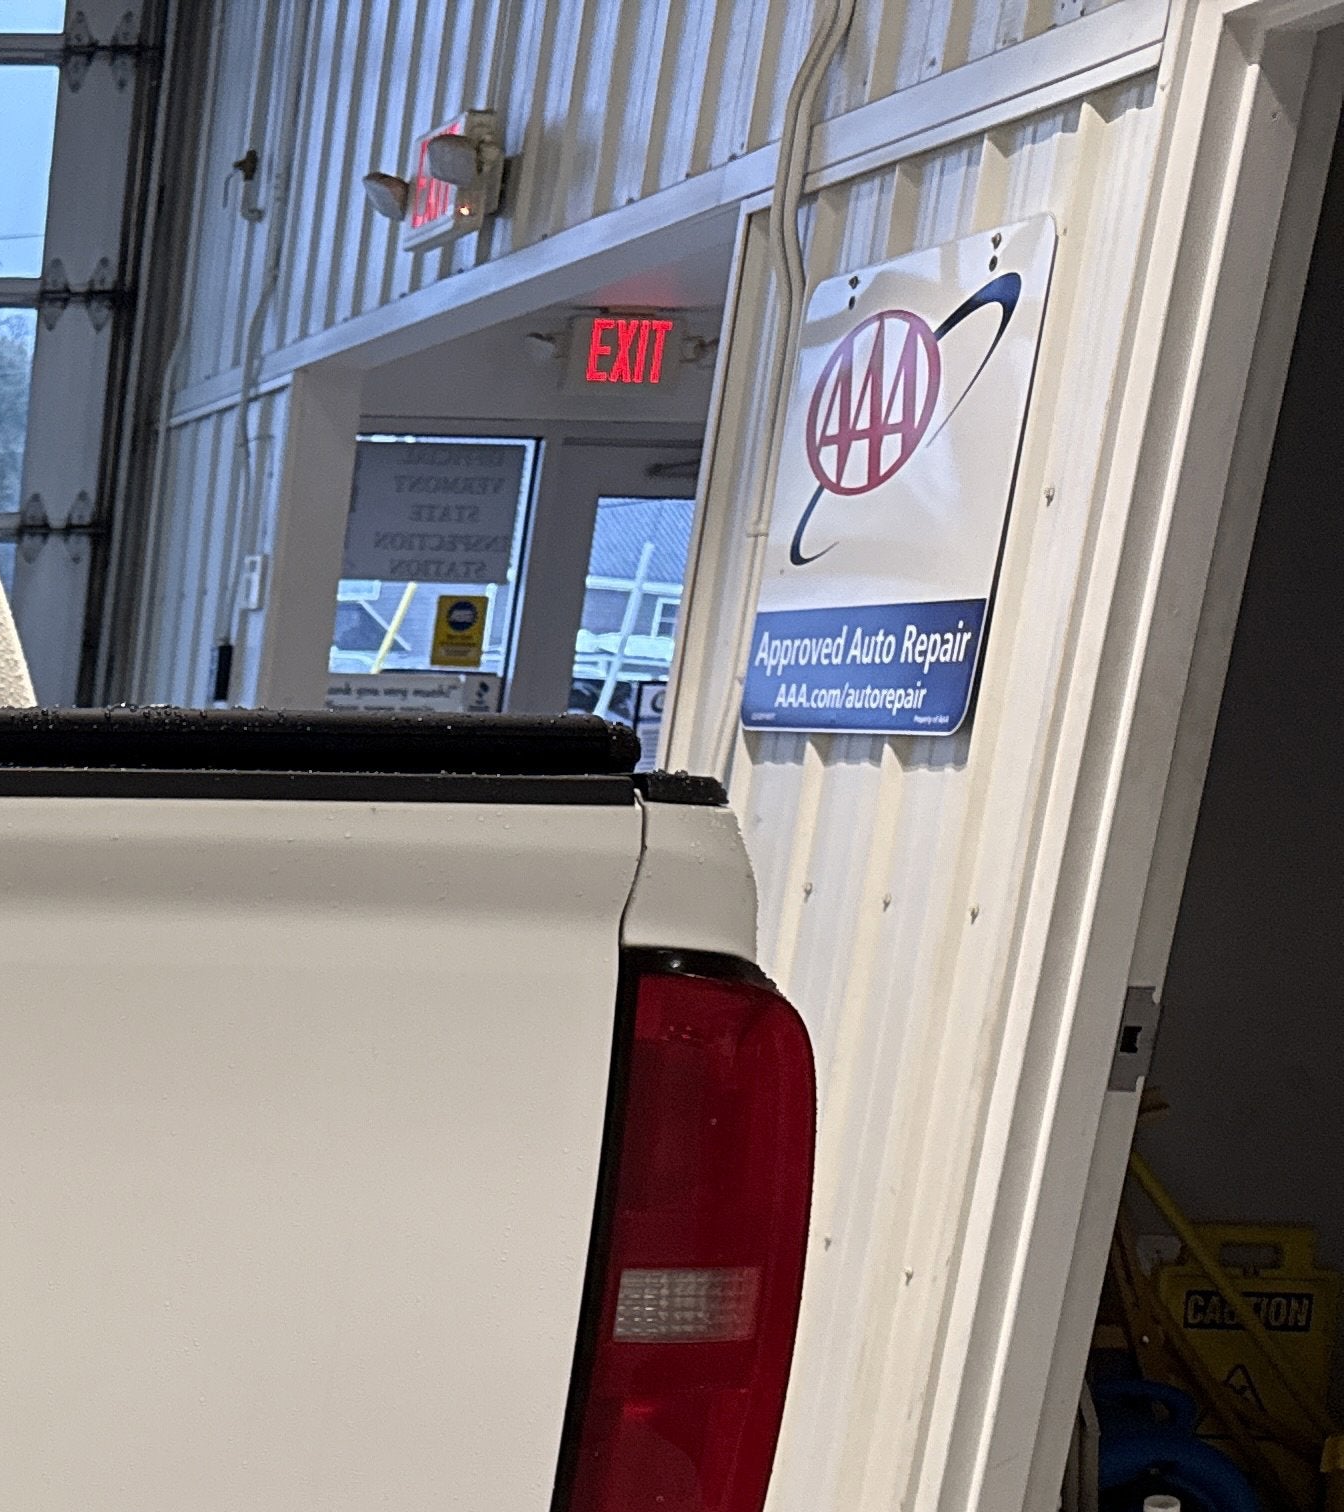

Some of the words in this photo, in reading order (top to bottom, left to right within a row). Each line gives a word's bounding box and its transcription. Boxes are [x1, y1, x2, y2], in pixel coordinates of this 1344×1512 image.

[586, 318, 673, 384] EXIT
[809, 311, 934, 492] AAA
[754, 624, 849, 677] Approved
[844, 626, 897, 666] Auto
[899, 620, 973, 675] Repair
[774, 680, 928, 716] AAA.com/autorepair
